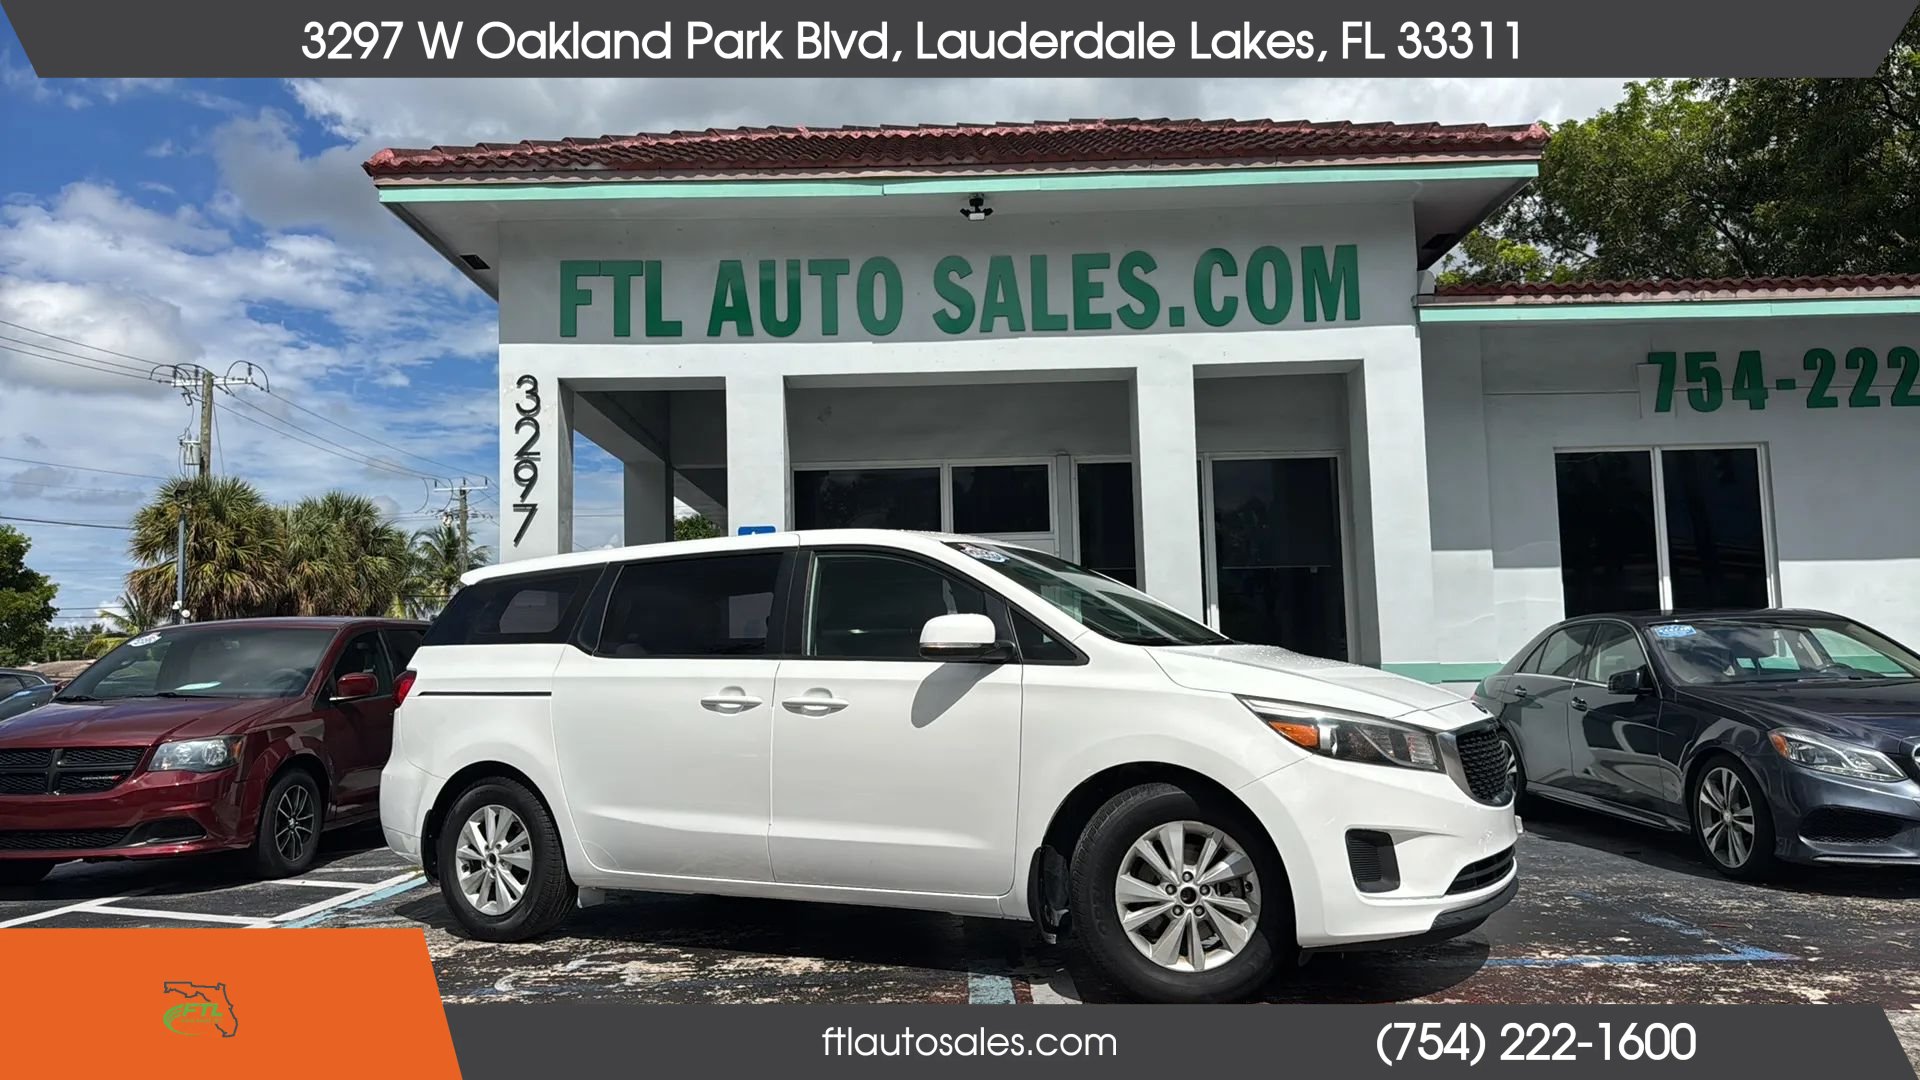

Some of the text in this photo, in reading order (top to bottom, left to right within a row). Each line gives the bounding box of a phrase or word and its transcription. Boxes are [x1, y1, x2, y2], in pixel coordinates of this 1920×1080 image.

[560, 244, 1361, 337] FTL AUTO SALES.COM
[1646, 346, 1920, 413] 754-222
[513, 374, 541, 548] 3297
